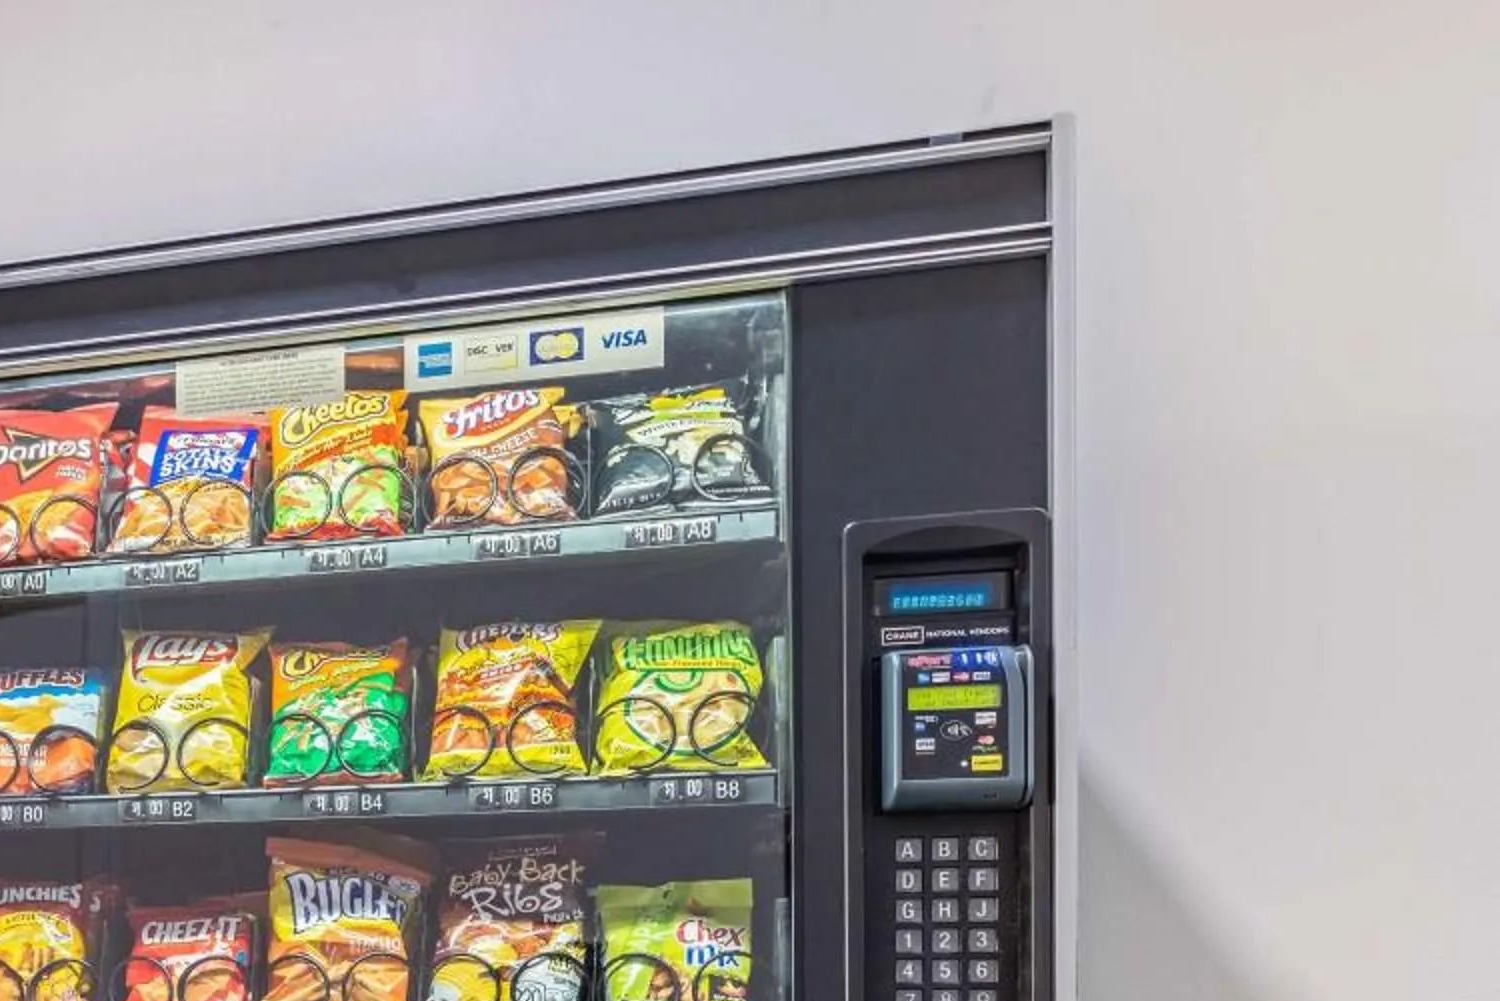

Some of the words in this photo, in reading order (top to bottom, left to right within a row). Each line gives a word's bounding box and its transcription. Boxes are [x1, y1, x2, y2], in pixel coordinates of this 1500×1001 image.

[602, 328, 647, 349] VISA
[467, 342, 514, 357] DISCVER
[282, 393, 389, 448] Cheetos
[159, 456, 238, 478] SKINS
[687, 521, 712, 542] A8
[533, 534, 557, 553] A6
[361, 548, 385, 566] A4
[174, 563, 197, 579] A2
[23, 573, 44, 590] A0
[136, 691, 214, 714] Classic
[531, 786, 553, 805] B6
[715, 781, 741, 799] B8
[172, 801, 194, 818] B2
[361, 794, 383, 812] B4
[23, 806, 44, 823] B0
[901, 842, 914, 858] A
[939, 841, 951, 857] B
[975, 839, 987, 857] C
[449, 861, 512, 896] Baby
[518, 857, 584, 886] Back
[902, 875, 914, 889] D
[939, 872, 949, 888] E
[975, 871, 987, 887] F
[462, 881, 564, 923] Ribs
[902, 903, 914, 920] G
[939, 903, 951, 918] H
[975, 901, 987, 917] J
[675, 917, 746, 948] Chex
[905, 933, 912, 949] 1
[939, 932, 951, 948] 2
[976, 931, 987, 948] 3
[902, 962, 914, 978] 4
[939, 962, 951, 979] 5
[976, 961, 988, 978] 6
